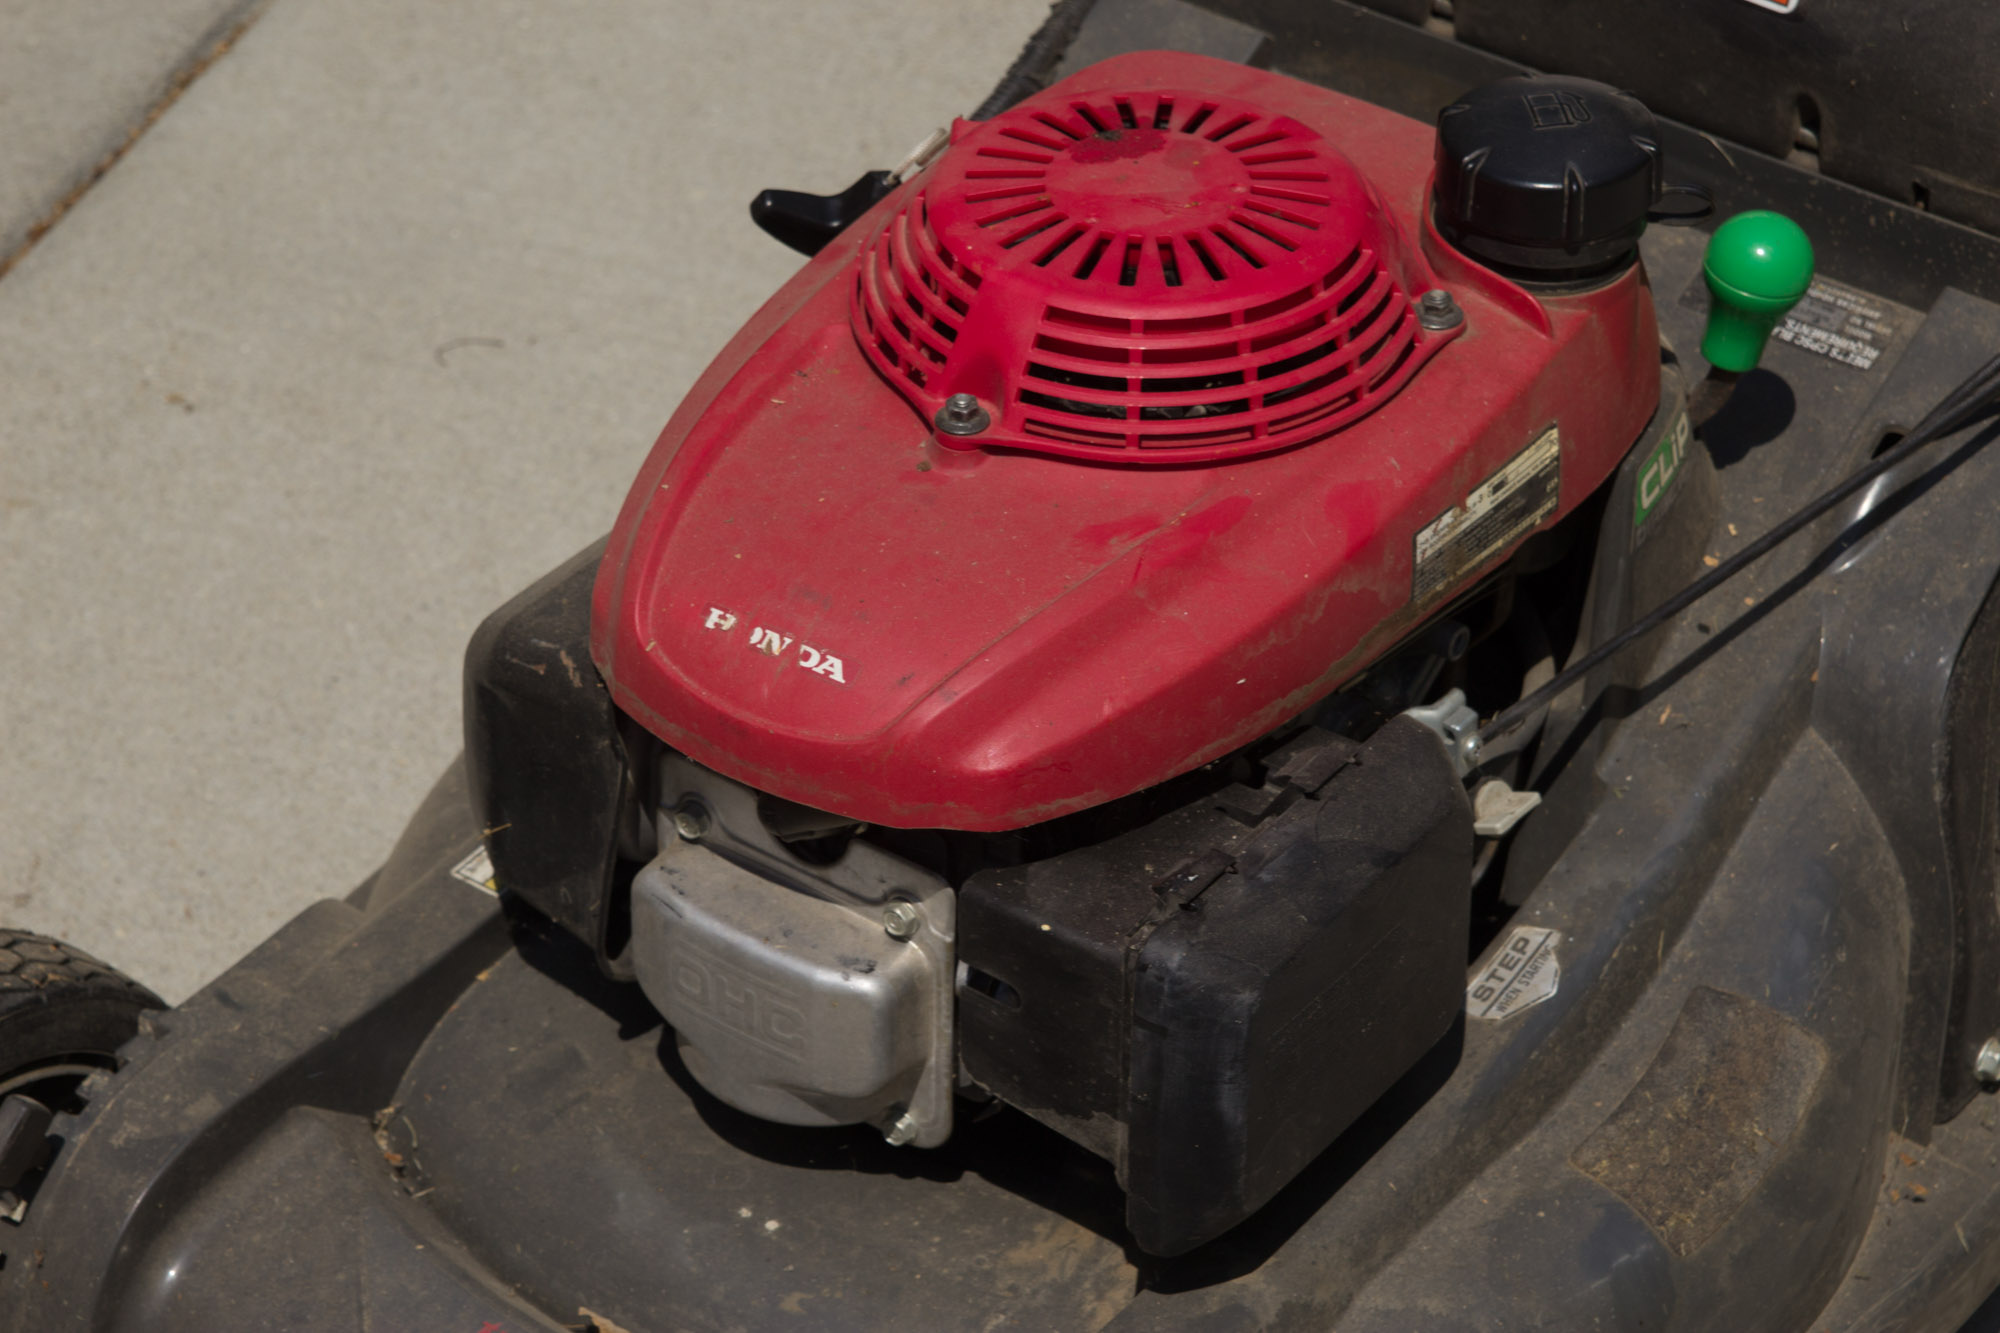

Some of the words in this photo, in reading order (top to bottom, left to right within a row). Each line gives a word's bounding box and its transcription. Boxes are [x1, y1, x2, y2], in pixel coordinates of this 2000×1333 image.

[1472, 937, 1530, 1002] STEP
[1496, 988, 1522, 1013] WHEN
[673, 955, 806, 1050] OHC
